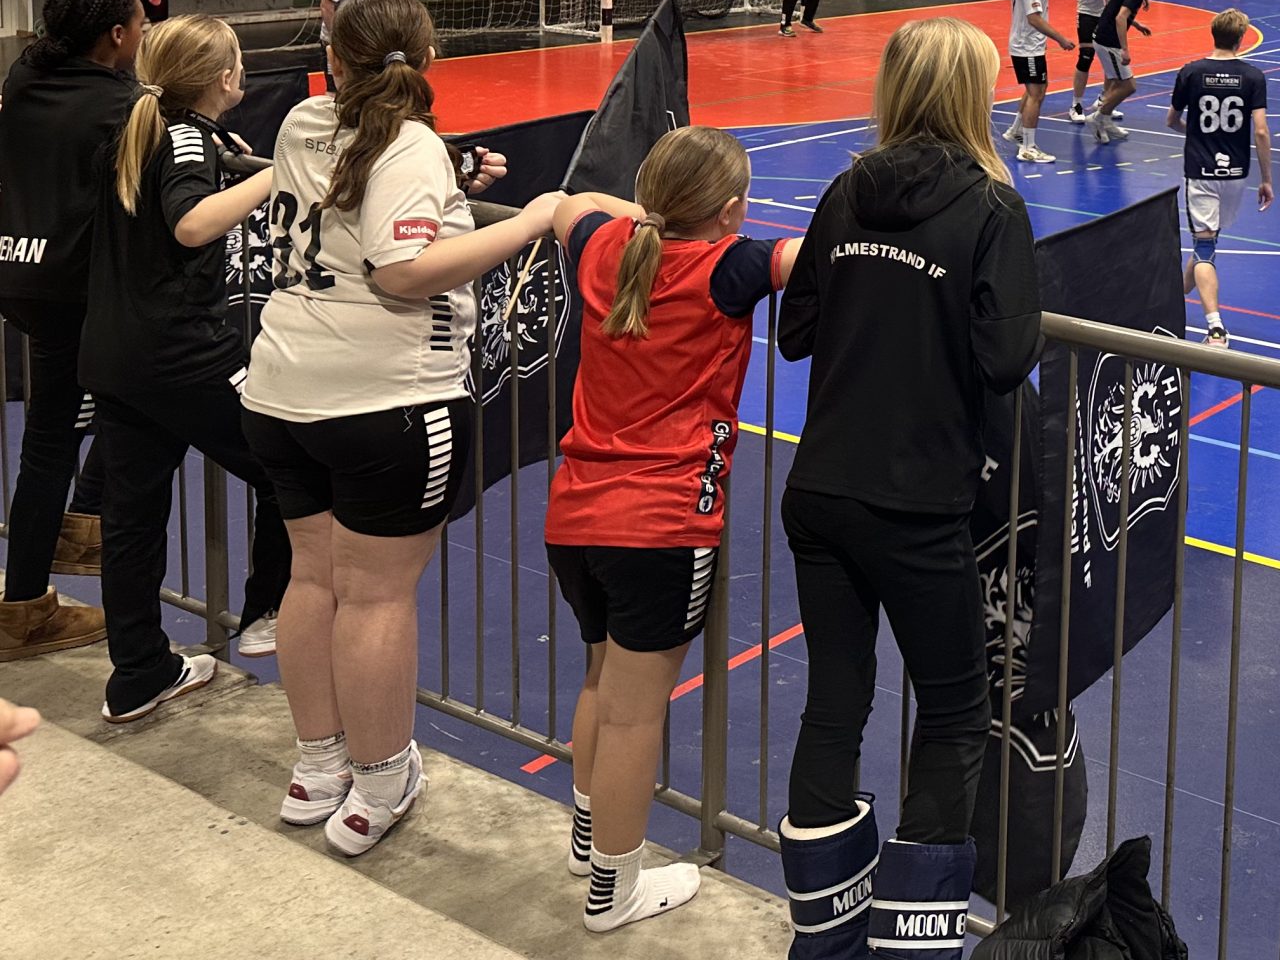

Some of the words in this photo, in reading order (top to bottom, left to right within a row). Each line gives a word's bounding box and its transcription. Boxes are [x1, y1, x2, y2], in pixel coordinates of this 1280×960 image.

[1198, 94, 1244, 134] 86
[1201, 167, 1244, 178] LOS
[0, 235, 48, 264] ERAN
[927, 263, 947, 279] IF
[1083, 559, 1092, 589] IF
[832, 873, 873, 917] MOON
[895, 912, 950, 937] MOON
